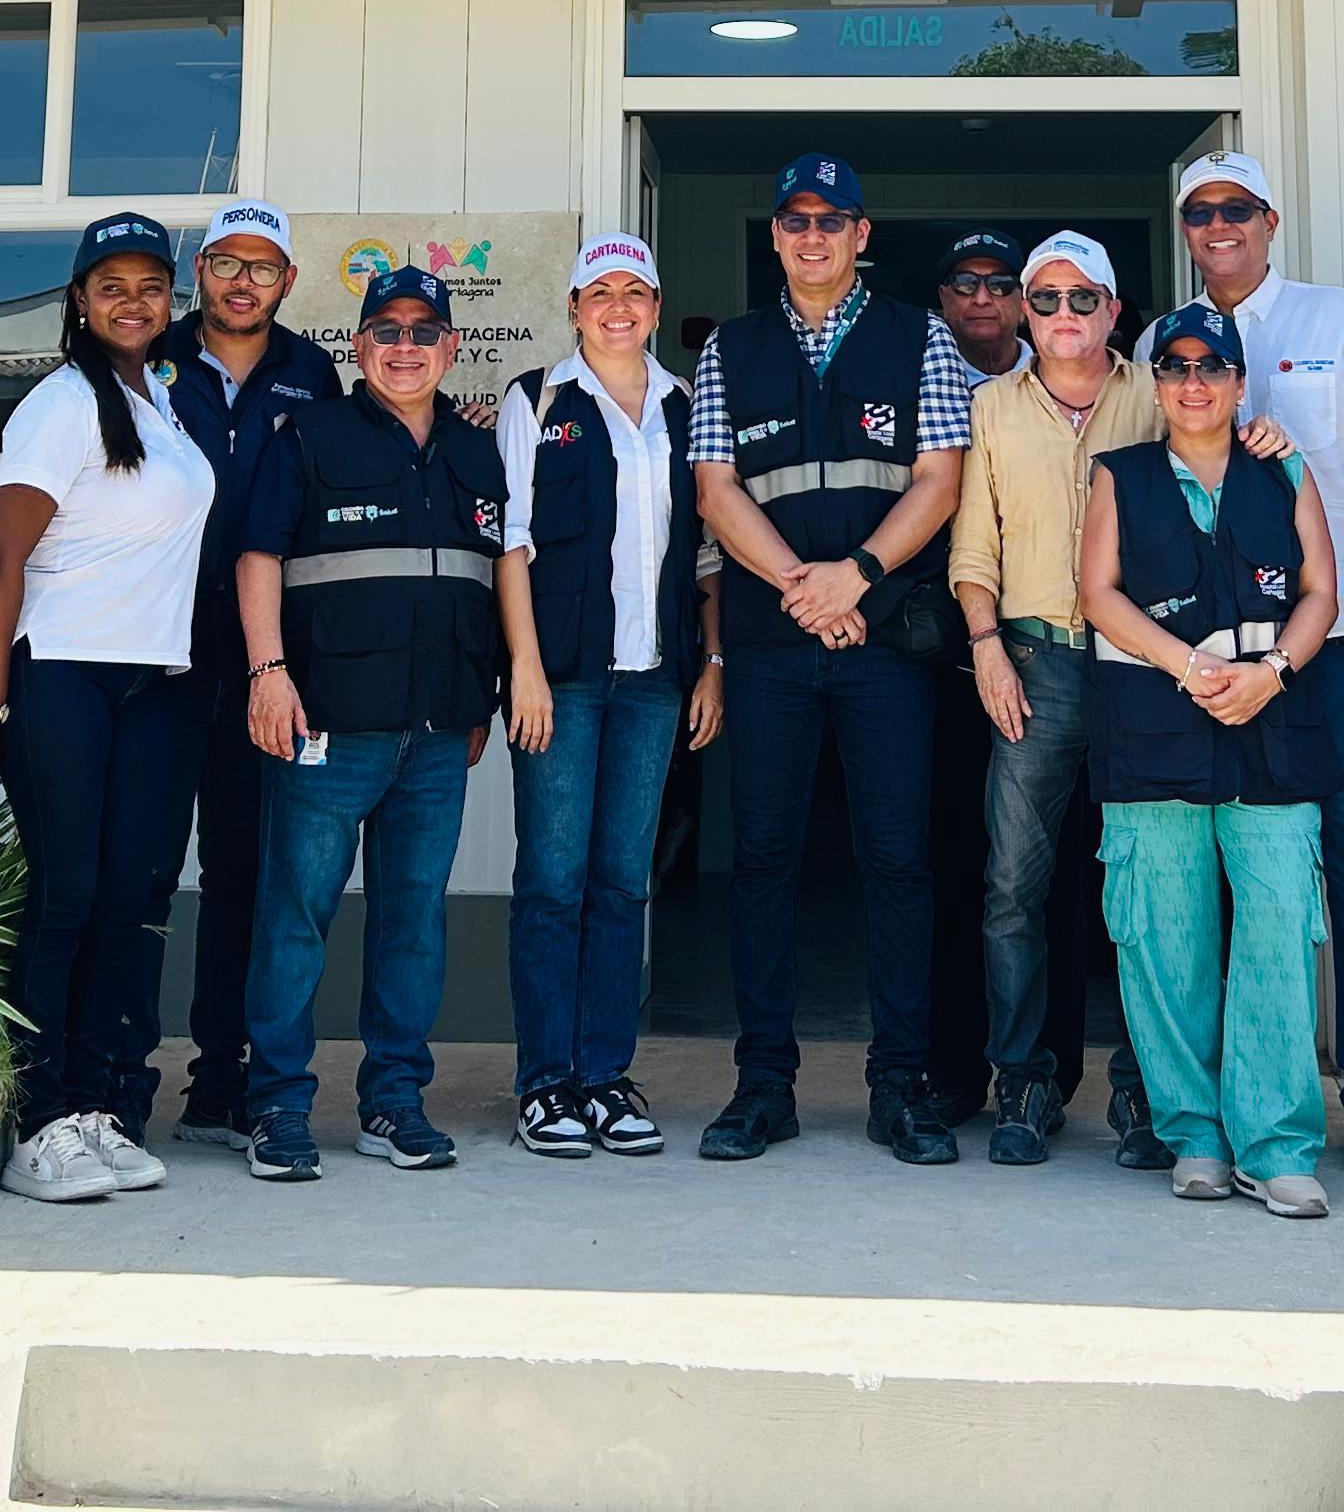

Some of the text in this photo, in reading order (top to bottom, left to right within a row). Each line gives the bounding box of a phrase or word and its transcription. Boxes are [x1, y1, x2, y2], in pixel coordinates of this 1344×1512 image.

[585, 243, 646, 266] CARTAGENA
[468, 277, 502, 286] Juntos
[301, 328, 353, 342] ALCAL
[469, 348, 482, 363] Y
[485, 348, 503, 363] C.
[452, 392, 498, 406] ALUD
